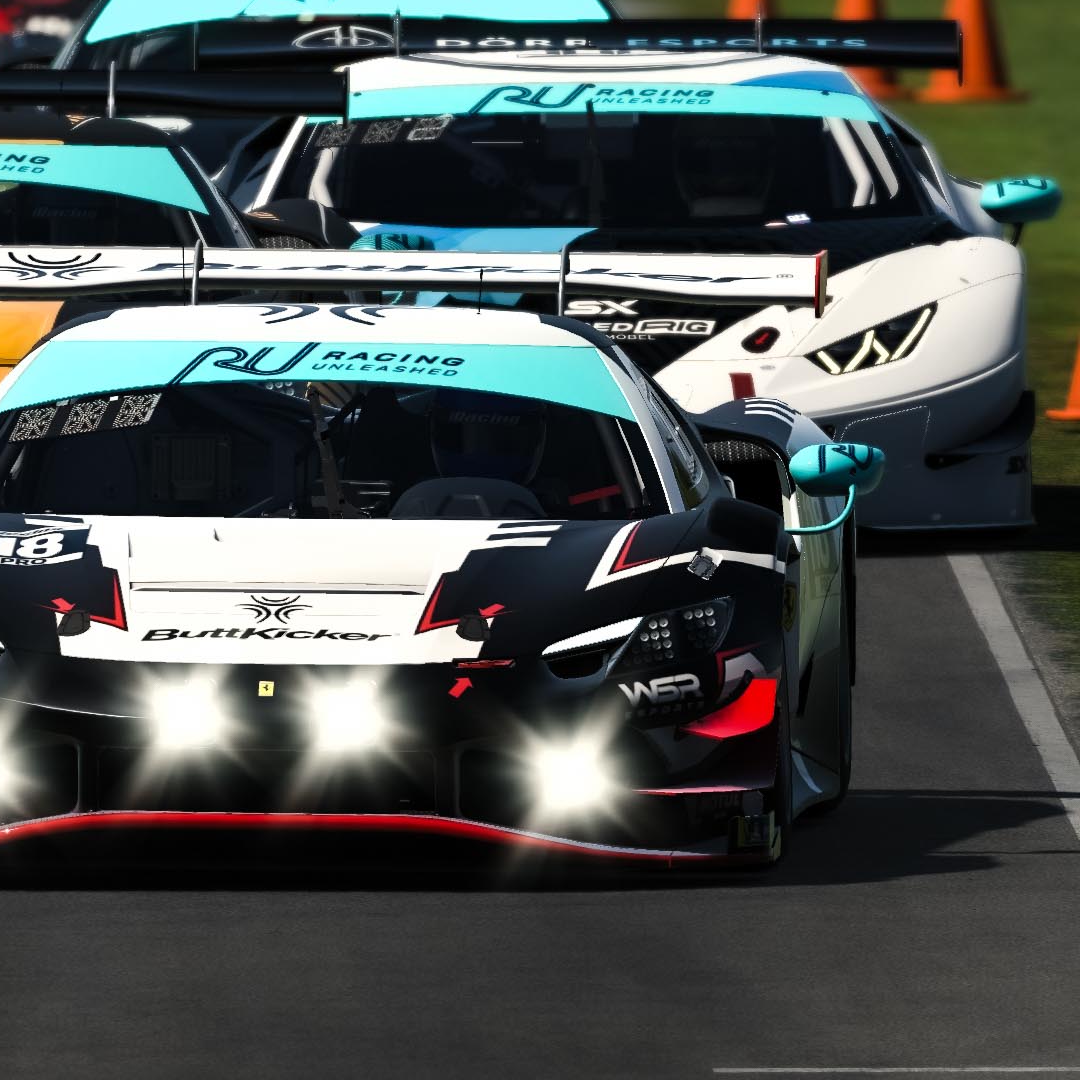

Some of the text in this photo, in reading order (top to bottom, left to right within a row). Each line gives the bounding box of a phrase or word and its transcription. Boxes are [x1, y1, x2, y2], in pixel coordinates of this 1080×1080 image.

[596, 88, 715, 98] RACING
[591, 97, 711, 105] UNLEASHED
[563, 299, 639, 316] SX
[322, 350, 466, 367] RACING
[312, 363, 458, 377] UNLEASHED
[0, 557, 47, 566] PRO
[141, 628, 392, 641] ButtKicker
[618, 673, 704, 707] WSR
